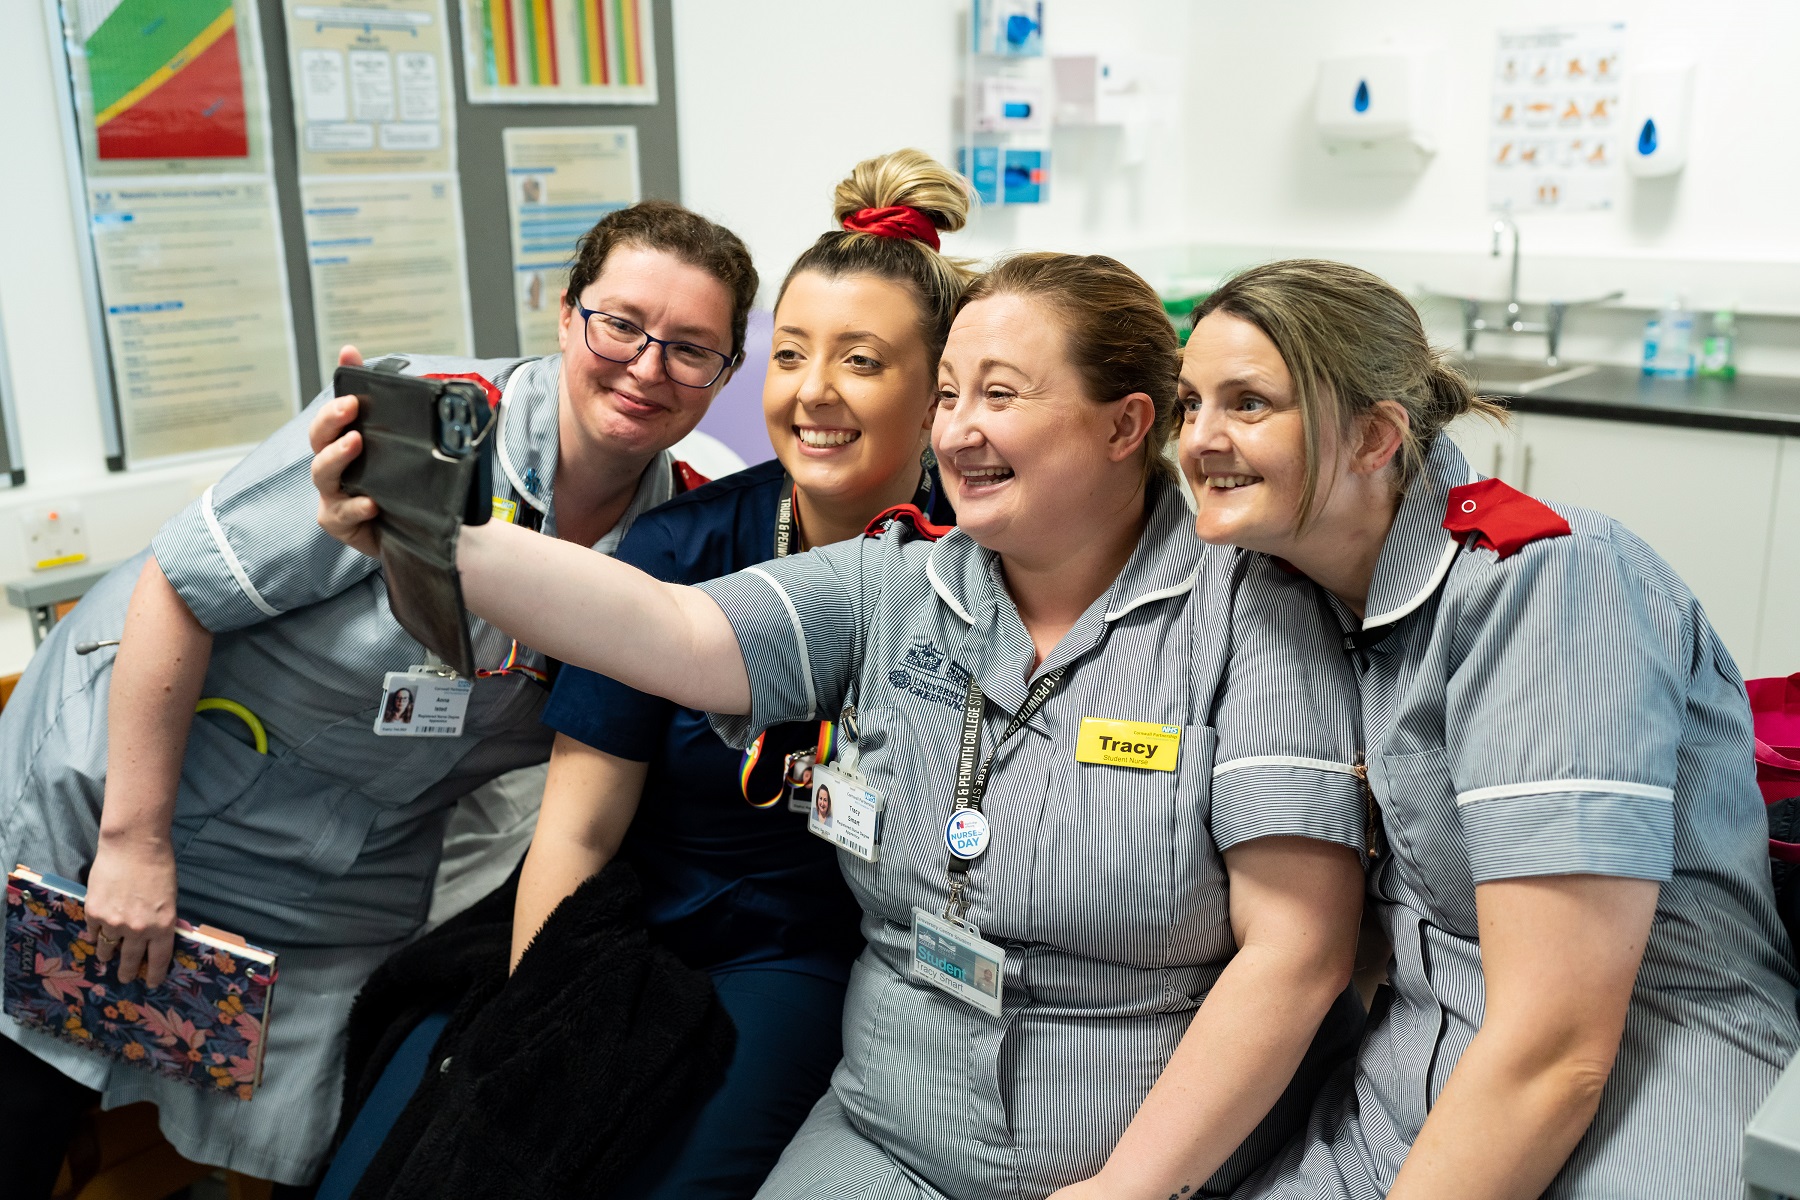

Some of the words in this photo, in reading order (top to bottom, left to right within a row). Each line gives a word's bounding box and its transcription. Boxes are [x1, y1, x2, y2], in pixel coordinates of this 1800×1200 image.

[779, 497, 791, 523] TRURO
[1044, 677, 1055, 688] &
[1020, 684, 1050, 721] PENWITH
[963, 706, 981, 745] COLLEGE
[1162, 726, 1178, 734] NHS
[1099, 735, 1159, 759] Tracy
[958, 746, 975, 787] PENWITH
[1103, 754, 1128, 763] Student
[1129, 757, 1149, 765] Nurse
[957, 785, 970, 796] &
[849, 805, 861, 817] Tracy
[847, 815, 860, 827] Smart
[957, 837, 980, 849] DAY
[916, 915, 939, 930] University
[918, 945, 967, 981] Student
[916, 960, 938, 979] Tracy
[939, 972, 964, 992] Smart
